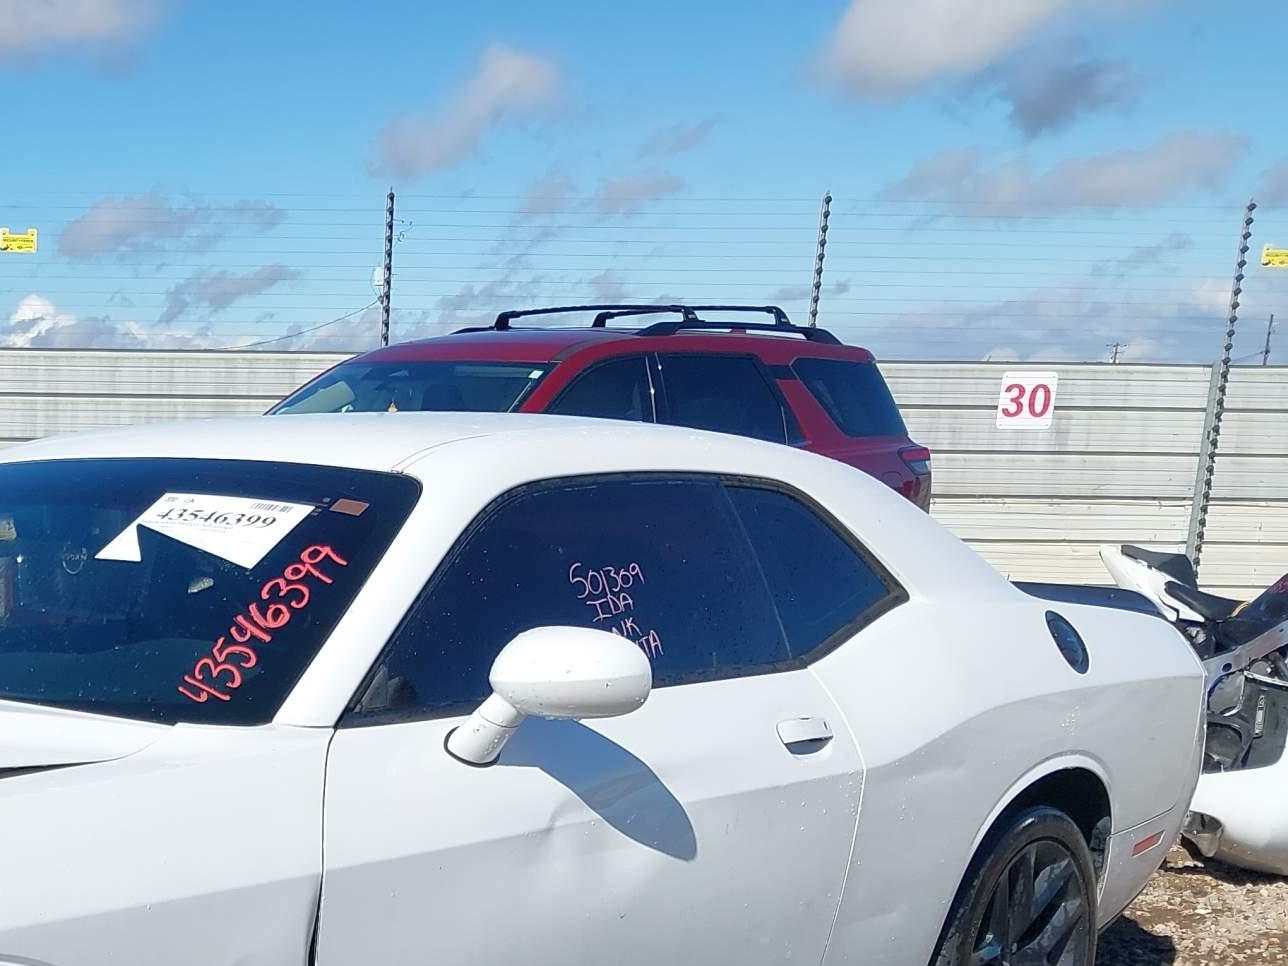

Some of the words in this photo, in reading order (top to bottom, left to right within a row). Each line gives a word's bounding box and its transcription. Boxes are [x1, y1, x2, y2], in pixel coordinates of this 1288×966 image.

[1001, 383, 1052, 418] 30
[155, 506, 278, 529] 43546399
[178, 544, 349, 704] 43546399
